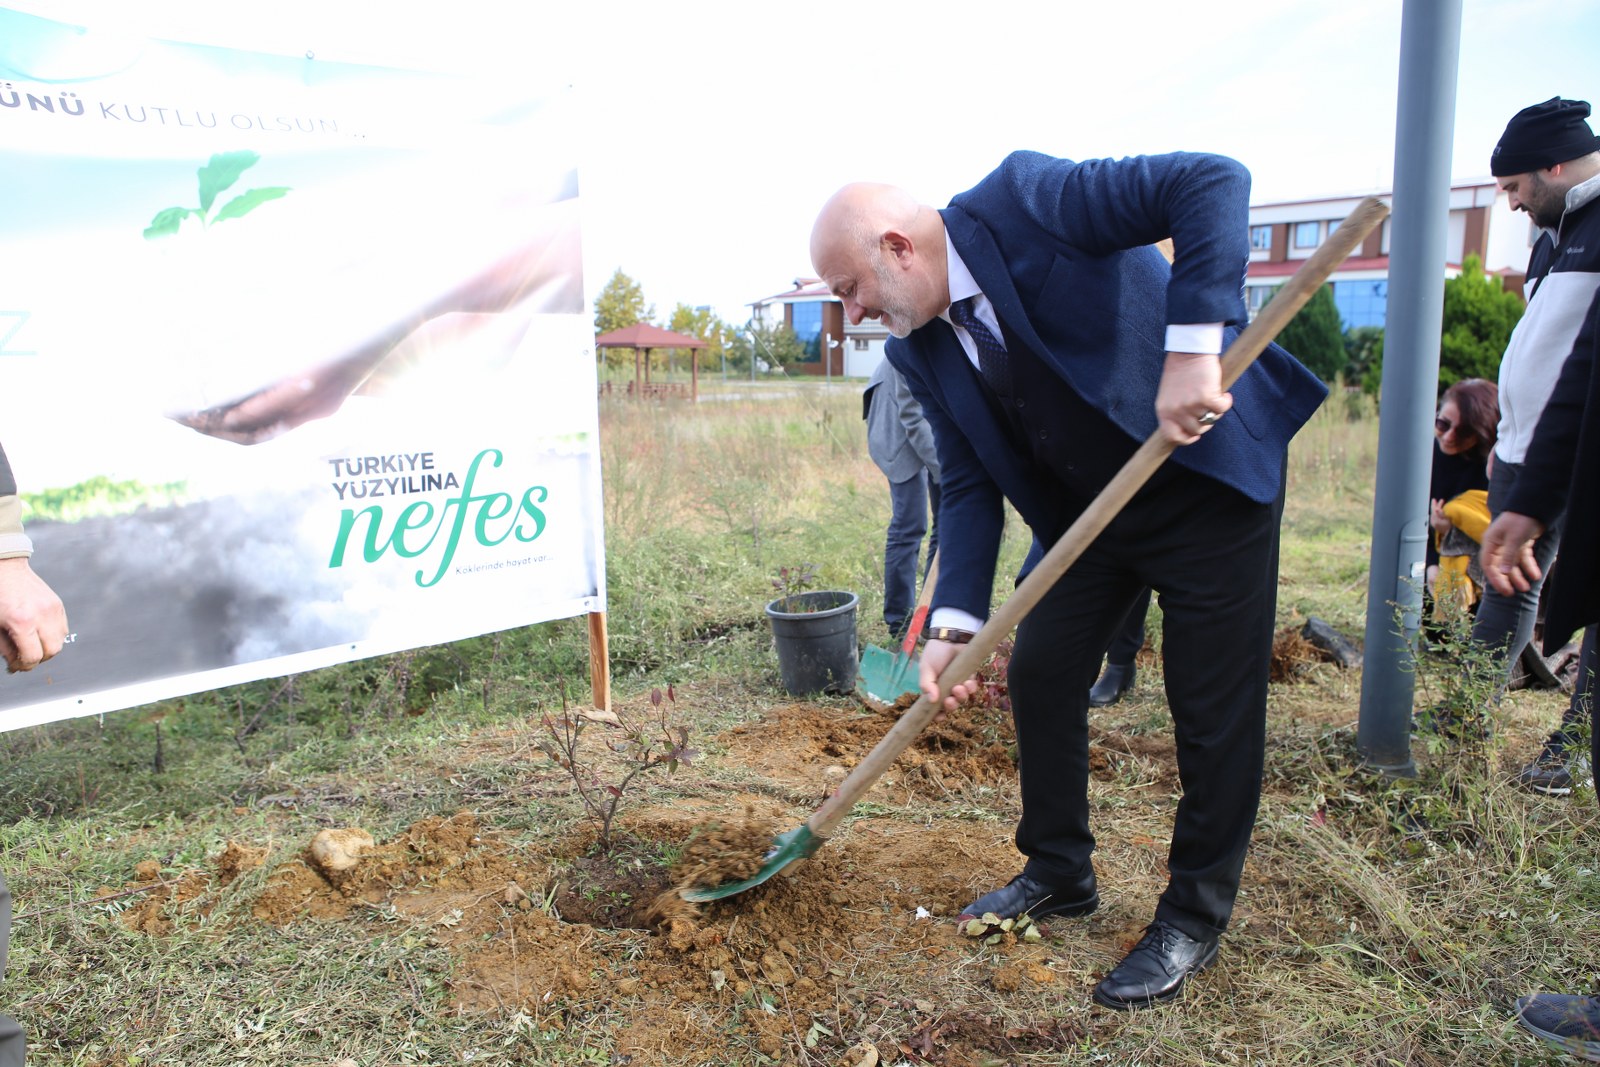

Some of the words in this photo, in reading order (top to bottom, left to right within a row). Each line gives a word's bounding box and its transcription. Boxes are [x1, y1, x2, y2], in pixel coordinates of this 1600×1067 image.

[99, 101, 217, 129] KUTLU
[331, 471, 460, 501] YÜZYILINA
[328, 448, 548, 588] nefes
[506, 555, 532, 569] hayat
